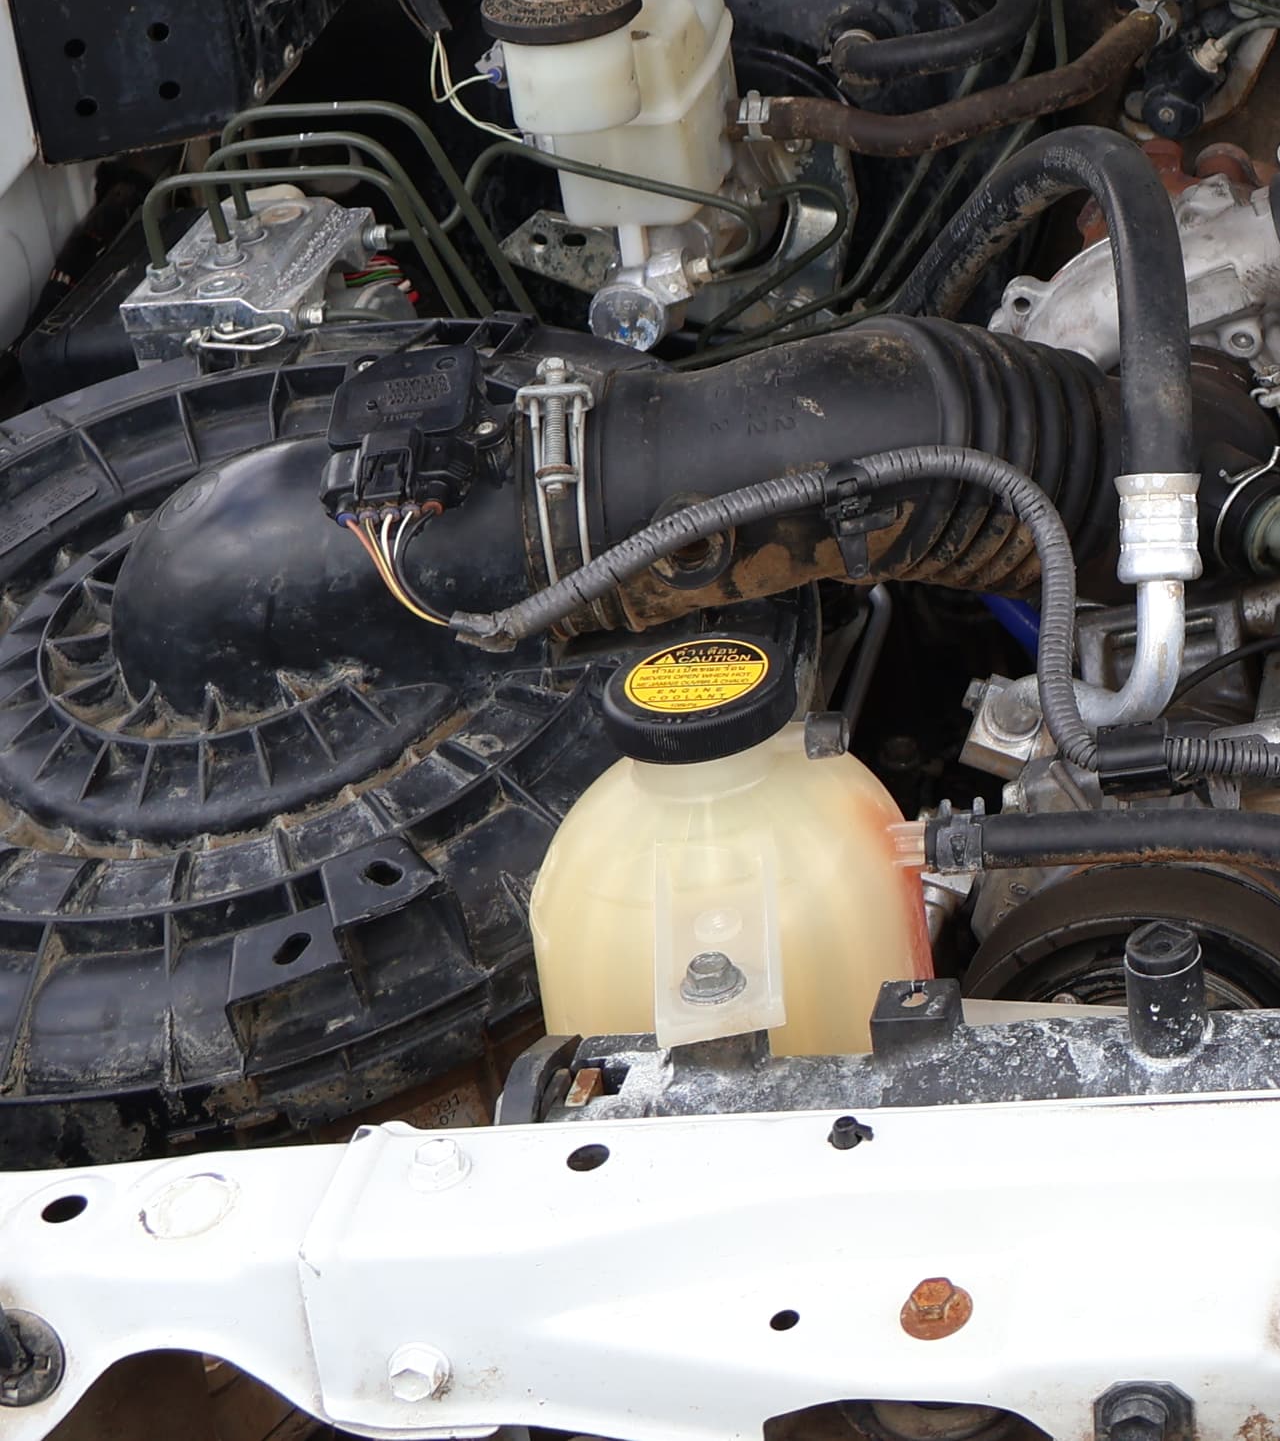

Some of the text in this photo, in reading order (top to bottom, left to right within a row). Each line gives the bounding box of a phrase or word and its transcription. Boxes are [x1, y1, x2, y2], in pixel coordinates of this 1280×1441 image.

[678, 654, 752, 664] CAUTION
[639, 673, 672, 681] NEVER
[656, 686, 725, 694] ENGINE
[648, 692, 727, 701] COOLANT
